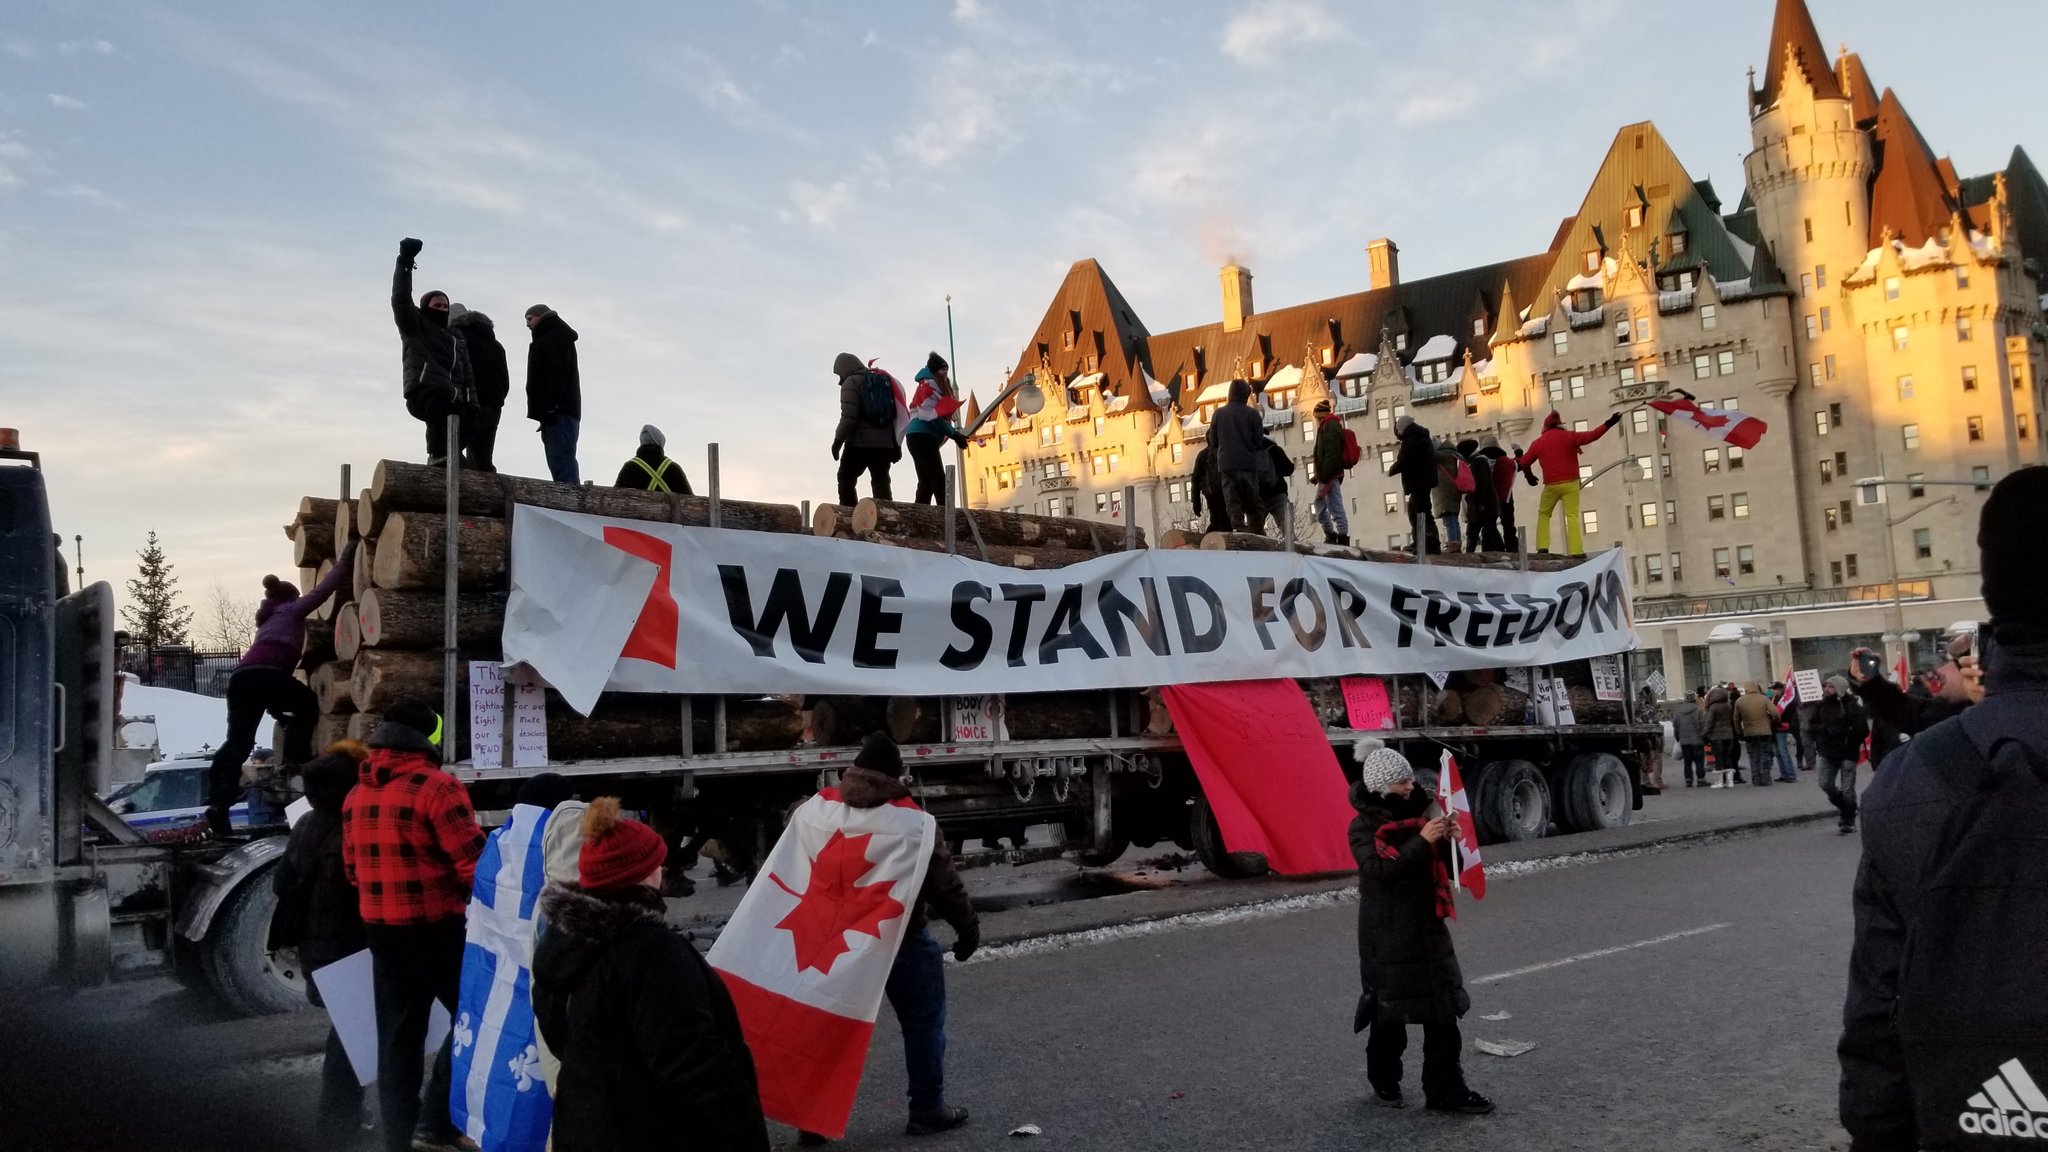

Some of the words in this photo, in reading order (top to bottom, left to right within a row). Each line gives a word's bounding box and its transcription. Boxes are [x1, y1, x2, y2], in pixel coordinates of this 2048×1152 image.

[717, 564, 906, 669] WE
[938, 576, 1228, 671] STAND
[1246, 576, 1373, 652] FOR
[1390, 569, 1633, 649] FREEDOM
[476, 666, 505, 680] Tha
[1601, 665, 1617, 675] OVE
[473, 684, 504, 695] Trucke
[1595, 676, 1620, 690] FEA
[957, 695, 984, 711] BODY
[962, 711, 978, 725] MY
[955, 726, 988, 739] HOICE
[1958, 1107, 2048, 1139] adida
